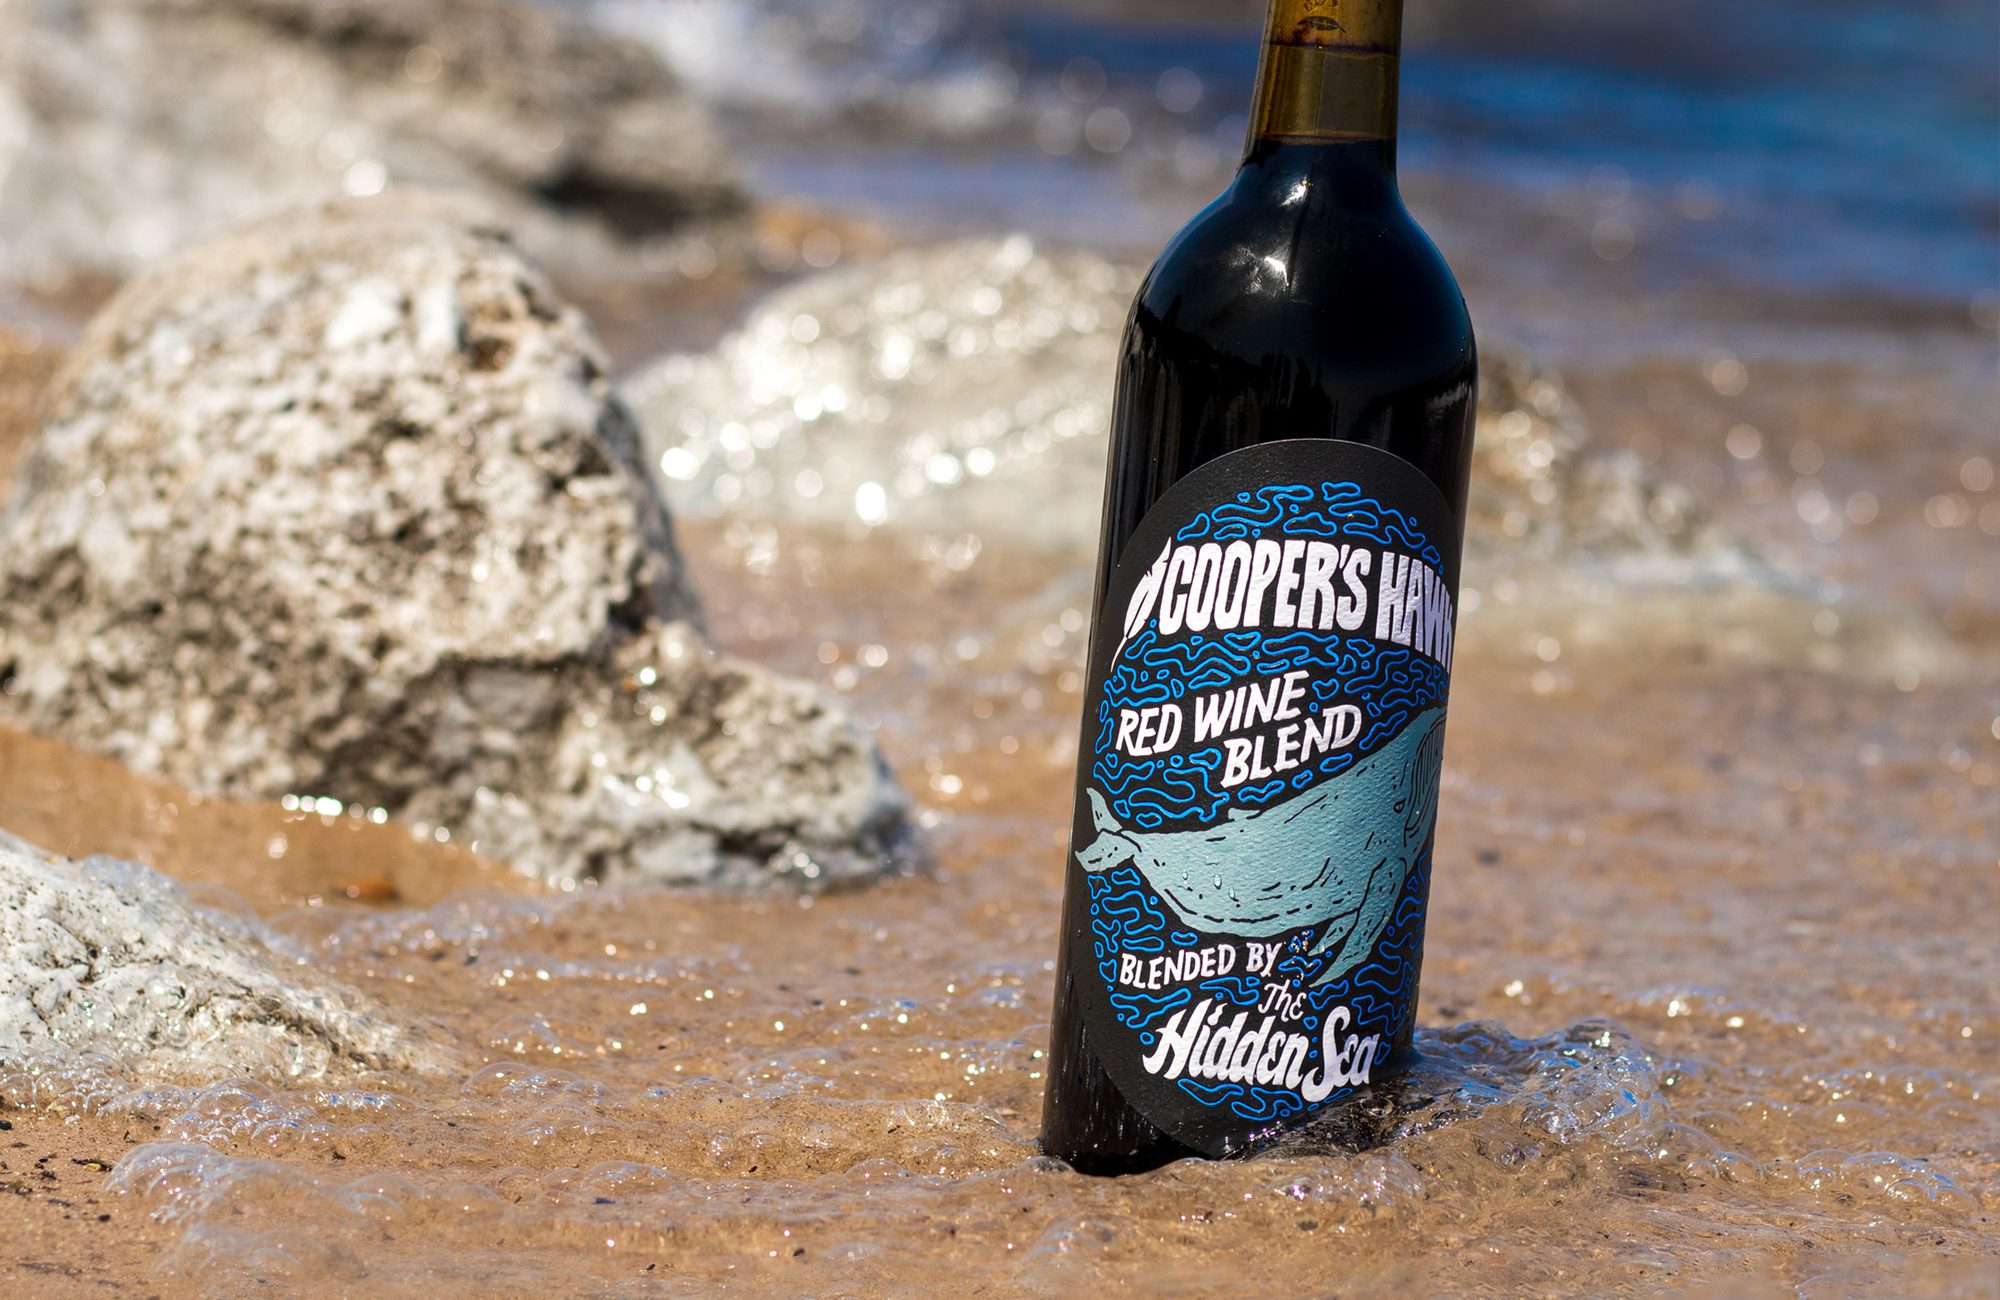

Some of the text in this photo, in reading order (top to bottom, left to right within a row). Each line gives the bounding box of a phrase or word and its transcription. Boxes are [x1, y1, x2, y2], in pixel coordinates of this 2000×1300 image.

[1159, 539, 1371, 635] COOPER'S
[1116, 670, 1309, 756] RED WINE
[1221, 704, 1362, 788] BLEND
[1119, 942, 1282, 990] BLENDED BY
[1259, 979, 1307, 1023] The
[1142, 998, 1380, 1102] Hidden Sea
